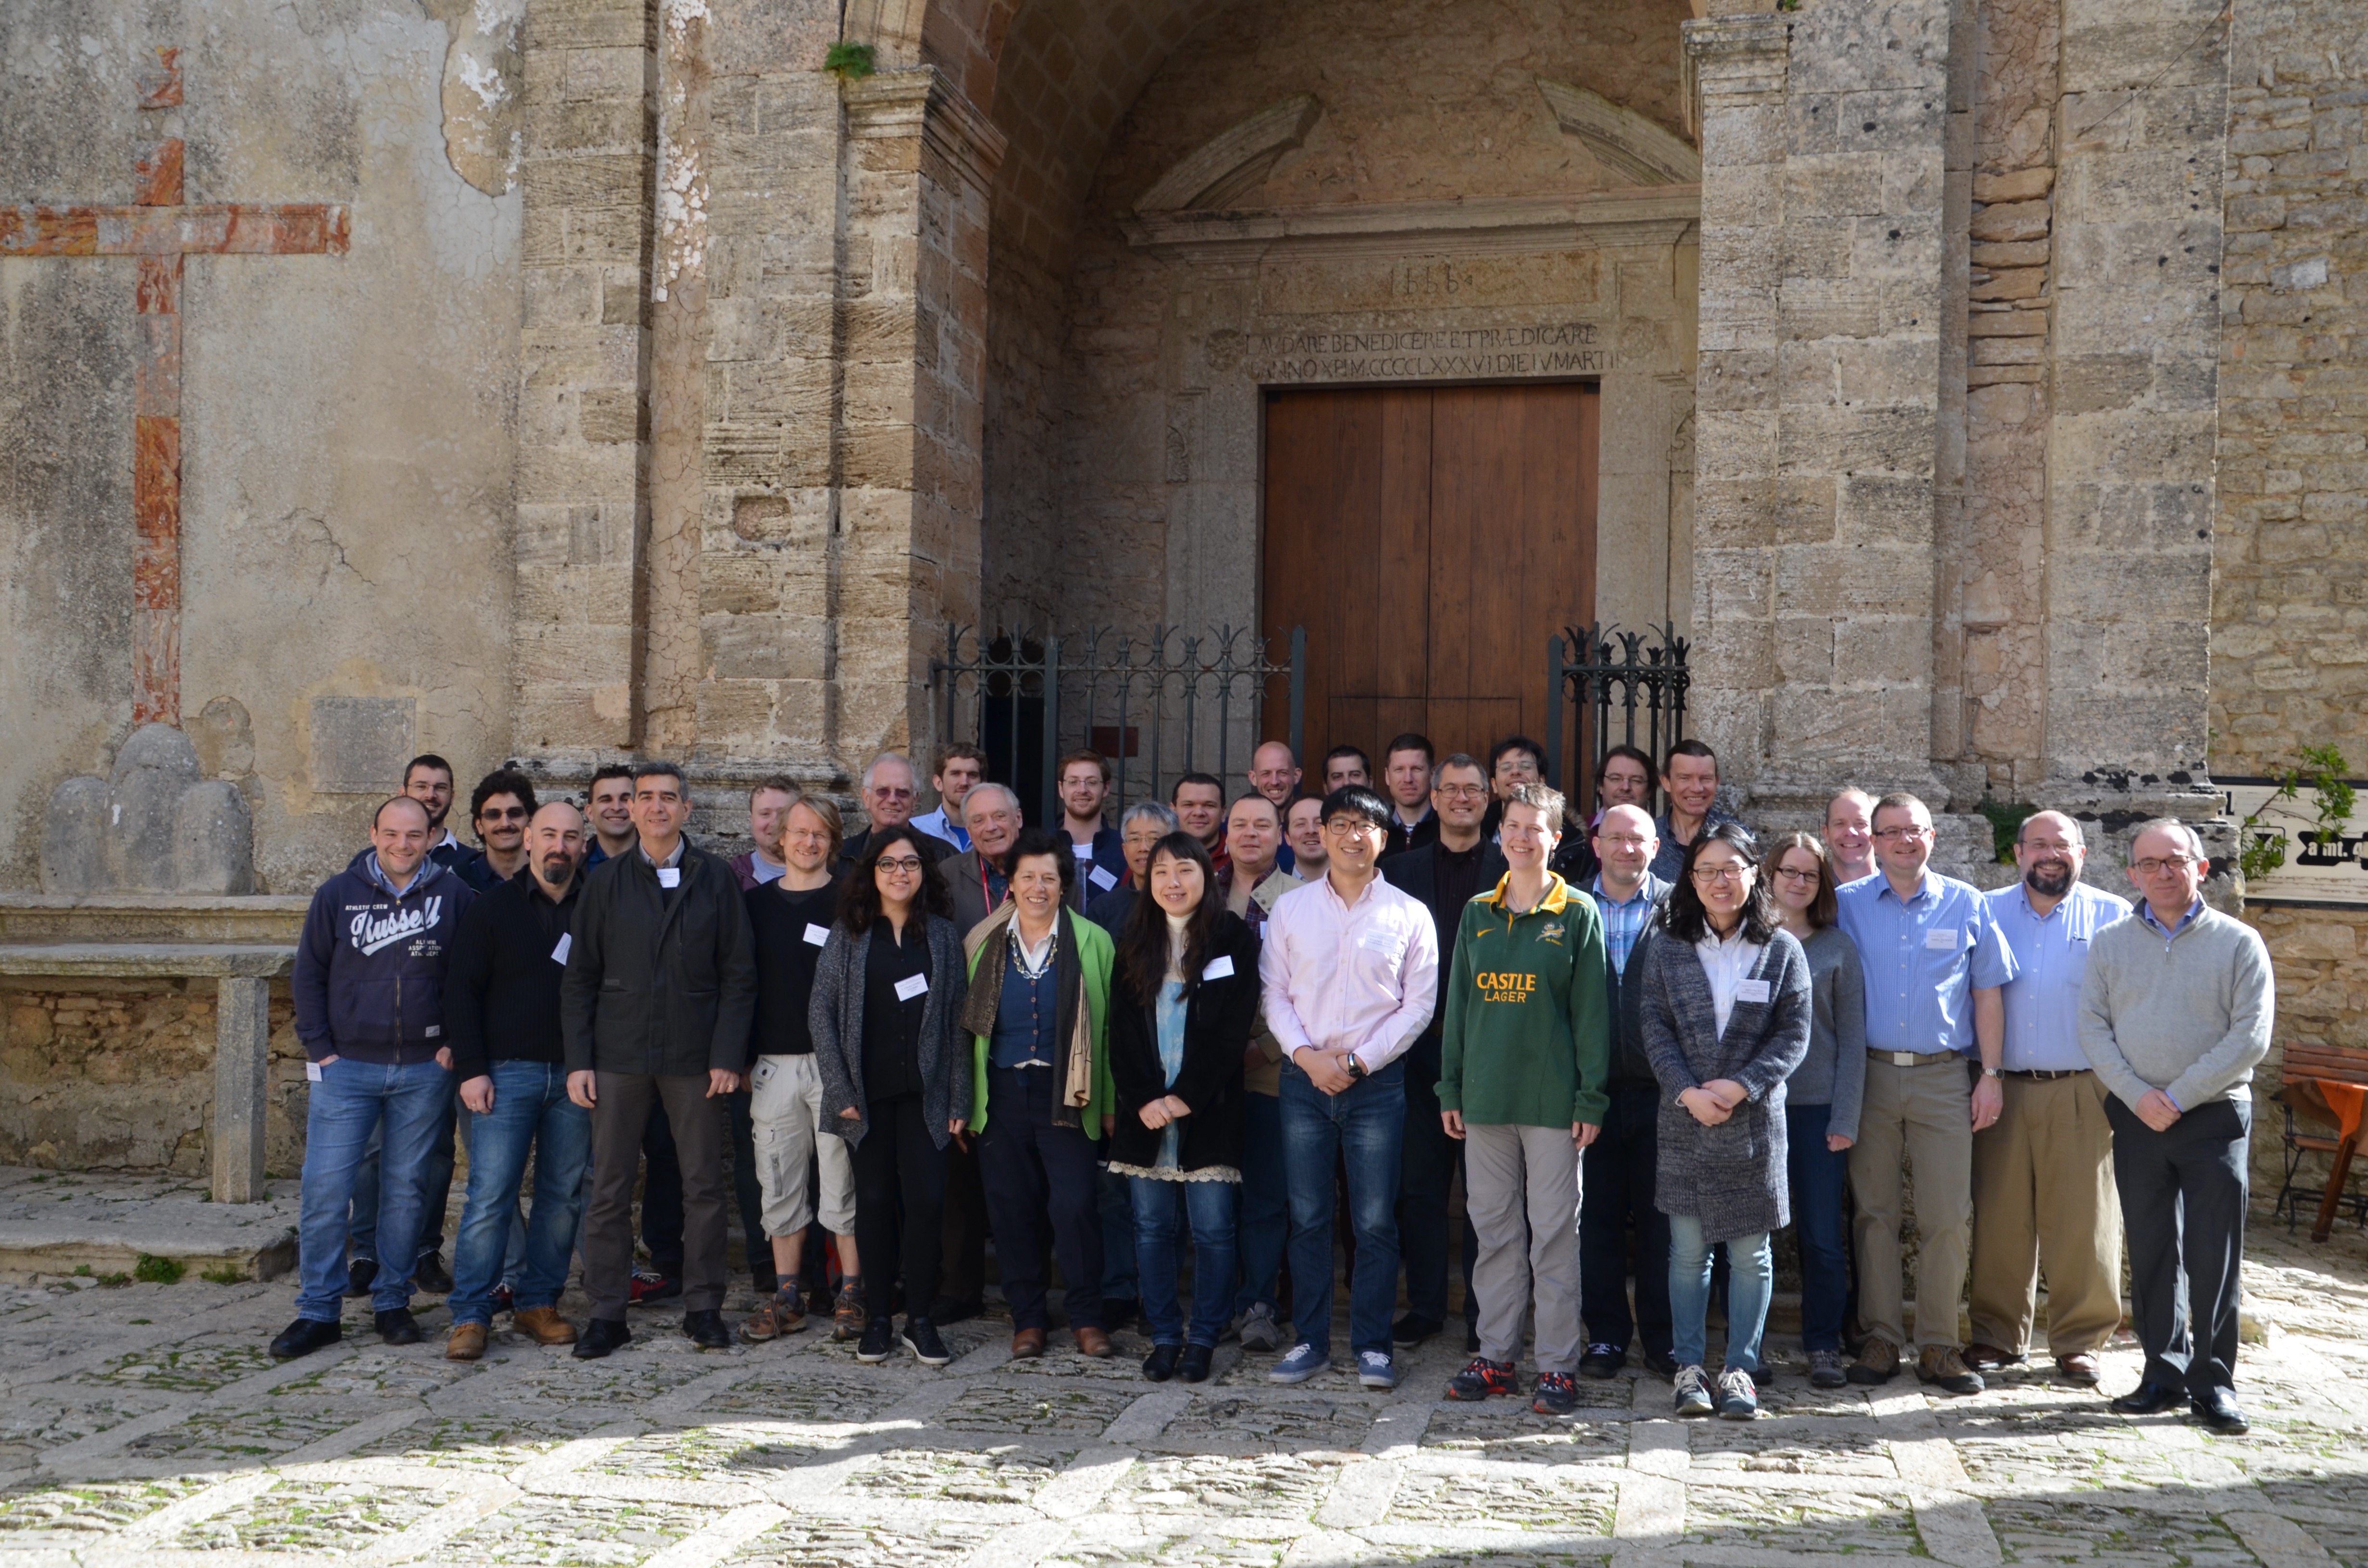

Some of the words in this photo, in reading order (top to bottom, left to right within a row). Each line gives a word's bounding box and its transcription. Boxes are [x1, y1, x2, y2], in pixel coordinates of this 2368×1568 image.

[1332, 331, 1446, 353] BENEDICERE
[350, 895, 442, 949] Russell
[1477, 972, 1536, 991] CASTLE
[1484, 990, 1527, 1003] LAGER
